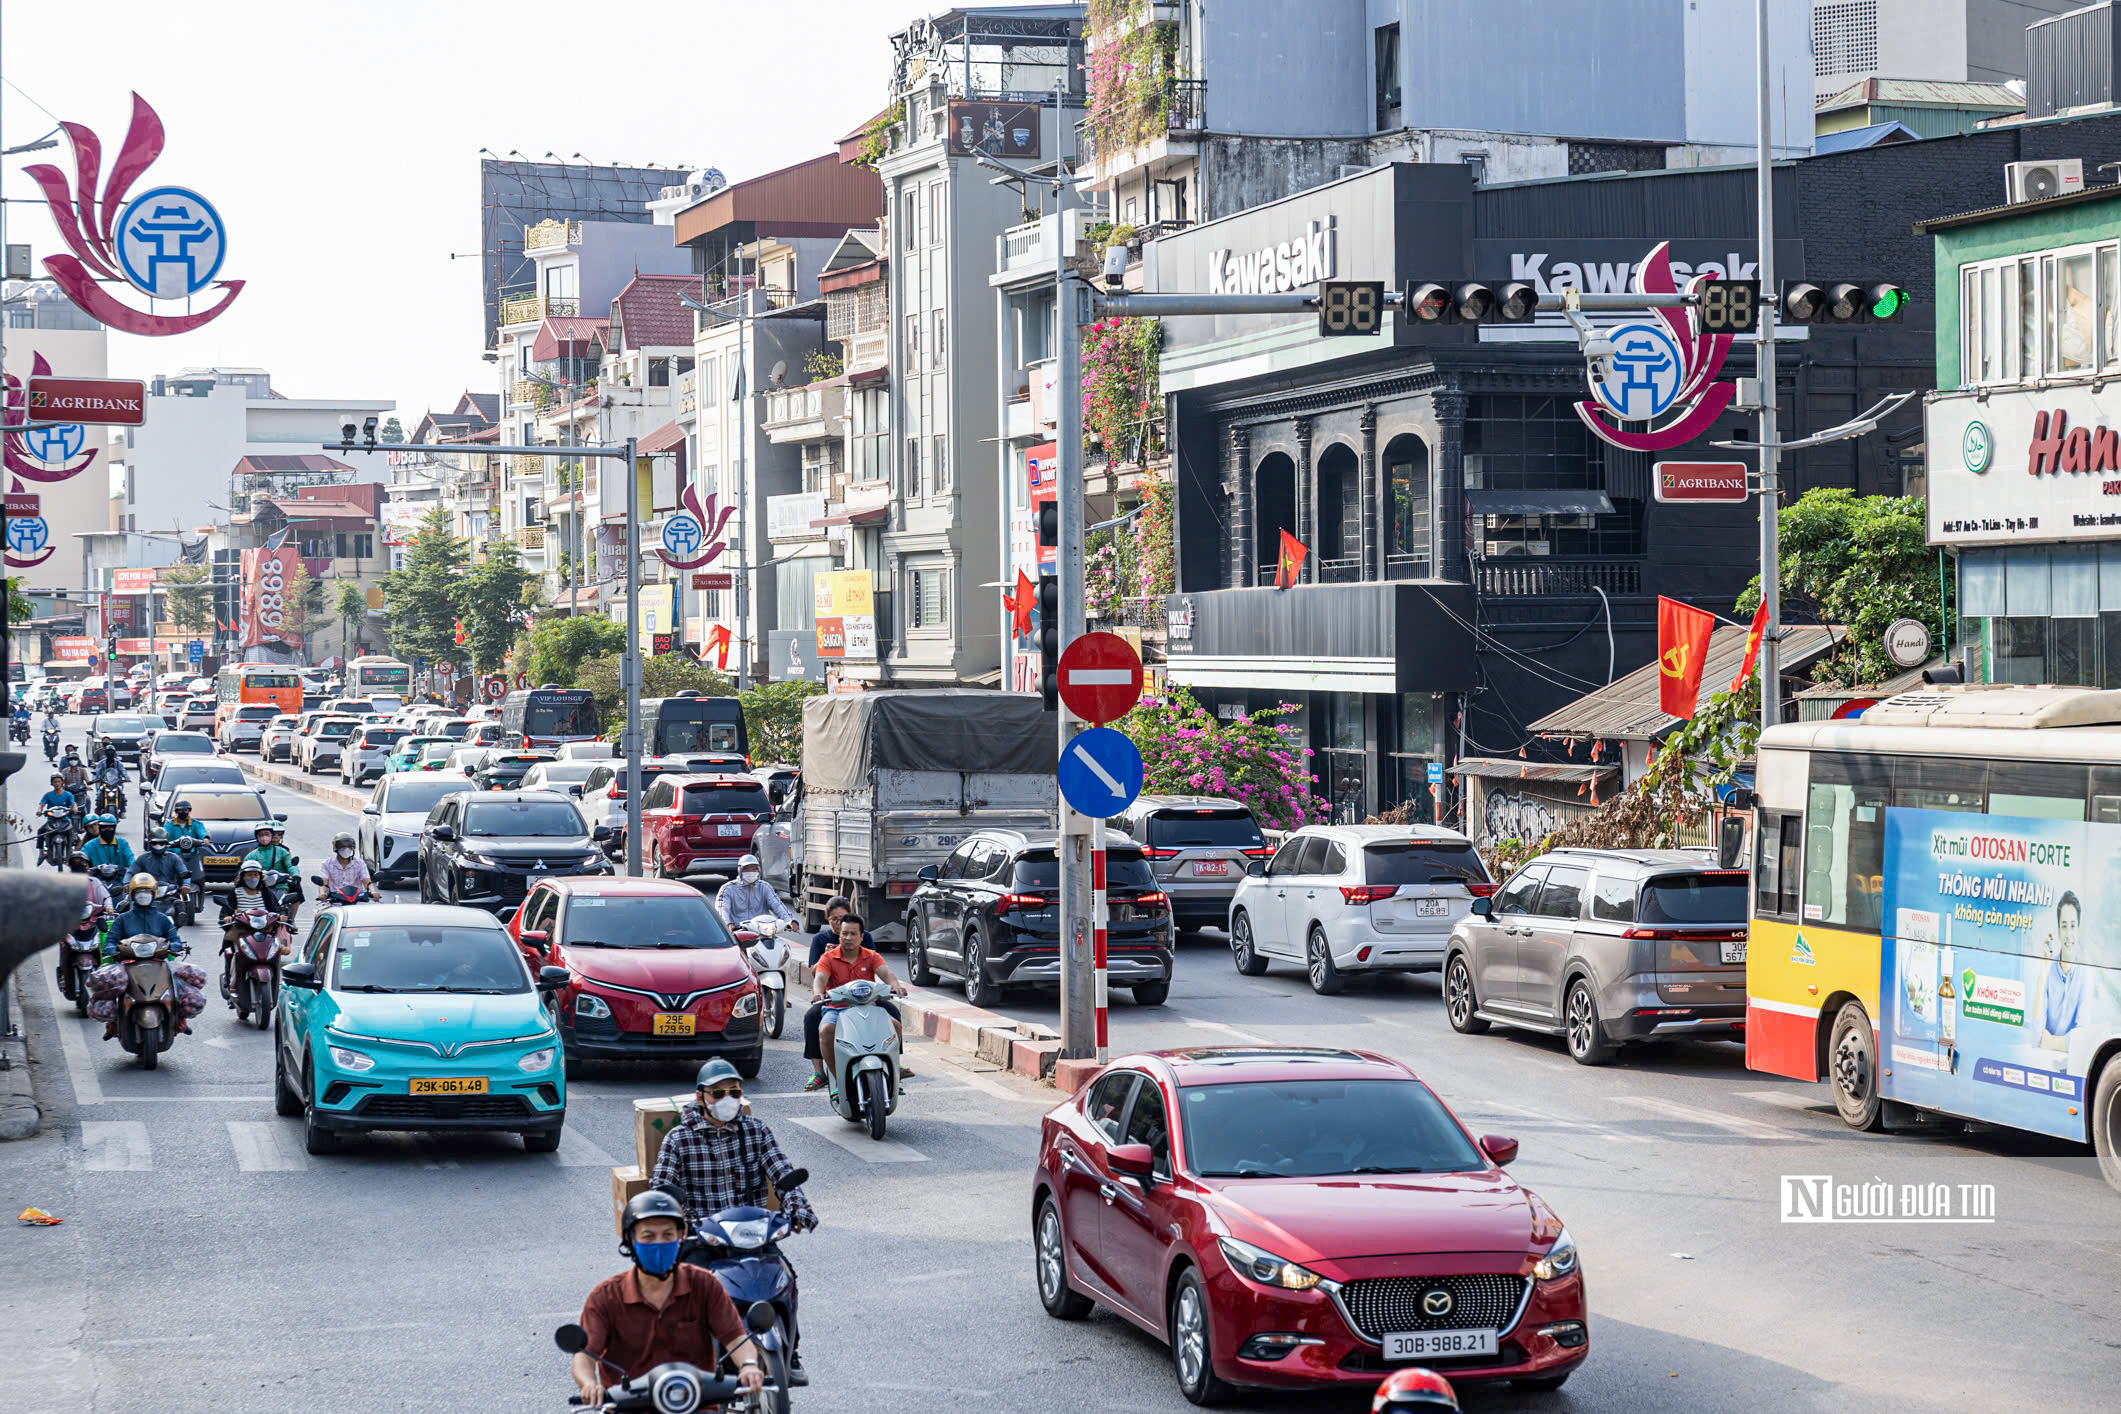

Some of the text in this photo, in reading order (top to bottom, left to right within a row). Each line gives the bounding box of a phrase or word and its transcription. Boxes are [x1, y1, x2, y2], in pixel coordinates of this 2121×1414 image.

[1209, 215, 1337, 294] Kawasaki
[50, 397, 140, 411] AGRIBANK
[2029, 408, 2121, 476] Han
[1678, 478, 1744, 489] AGRIBANK
[2103, 480, 2121, 496] PAK
[1169, 611, 1185, 624] MAX
[1169, 625, 1191, 639] MOTO
[1896, 637, 1924, 648] Handi
[1934, 834, 2071, 868] Xịt mũi OTOSAN FORTE
[1938, 868, 2054, 908] THÔNG MŨI NHANH
[1954, 904, 1984, 927] không
[1985, 907, 2003, 926] còn
[1726, 952, 1748, 962] 567.
[1976, 985, 1998, 1000] KHÔNG
[666, 1015, 683, 1024] 29E
[659, 1025, 691, 1034] 129.59
[416, 1080, 482, 1092] 29K-061.48
[1394, 1333, 1486, 1355] 30B-988.21
